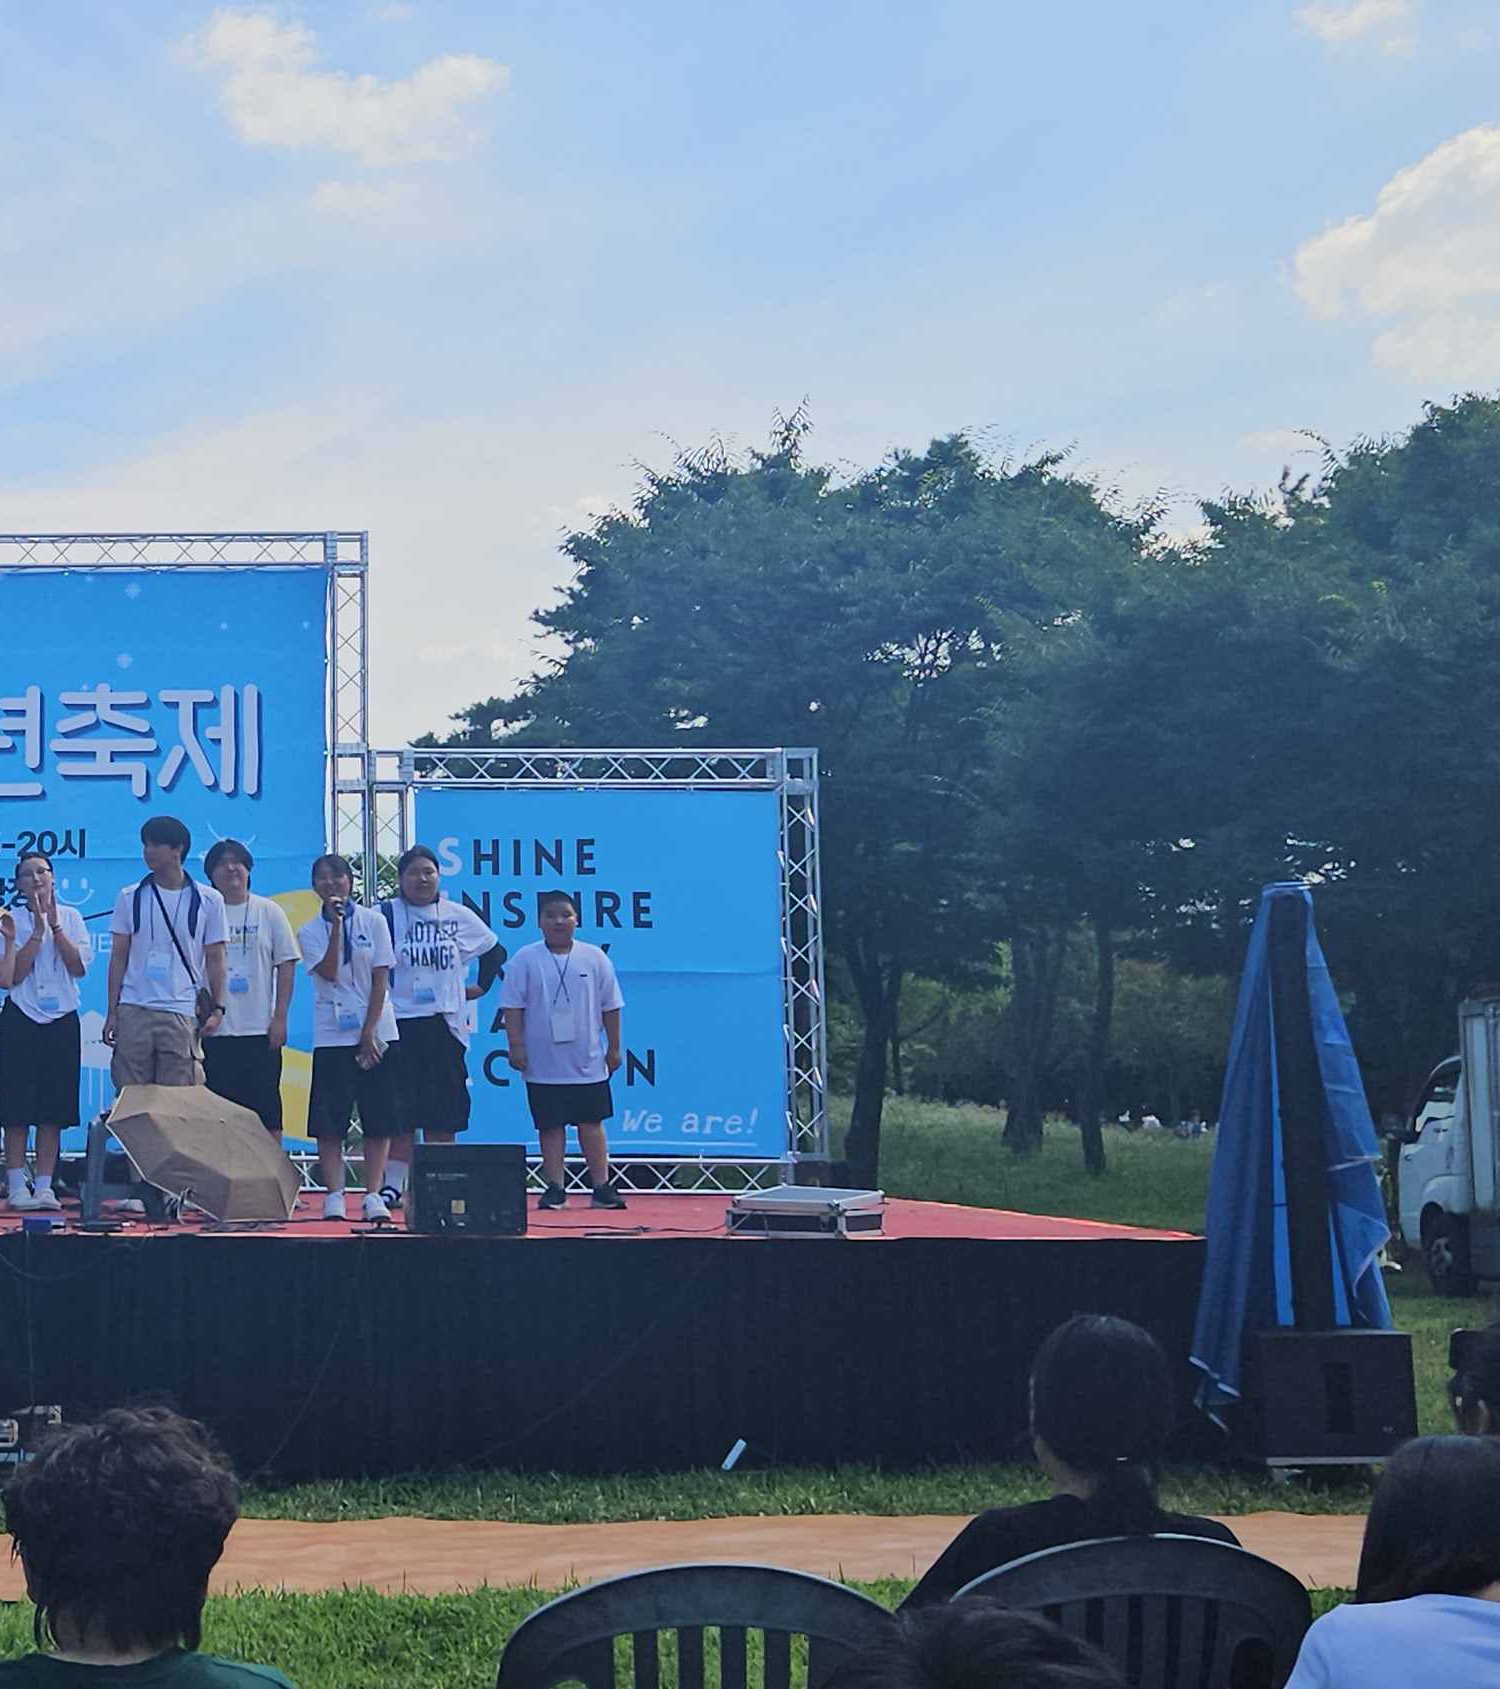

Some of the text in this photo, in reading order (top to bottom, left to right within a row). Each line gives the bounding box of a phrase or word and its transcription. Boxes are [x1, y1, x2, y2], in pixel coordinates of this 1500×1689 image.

[437, 837, 597, 877] SHINE
[621, 1107, 759, 1135] We are!
